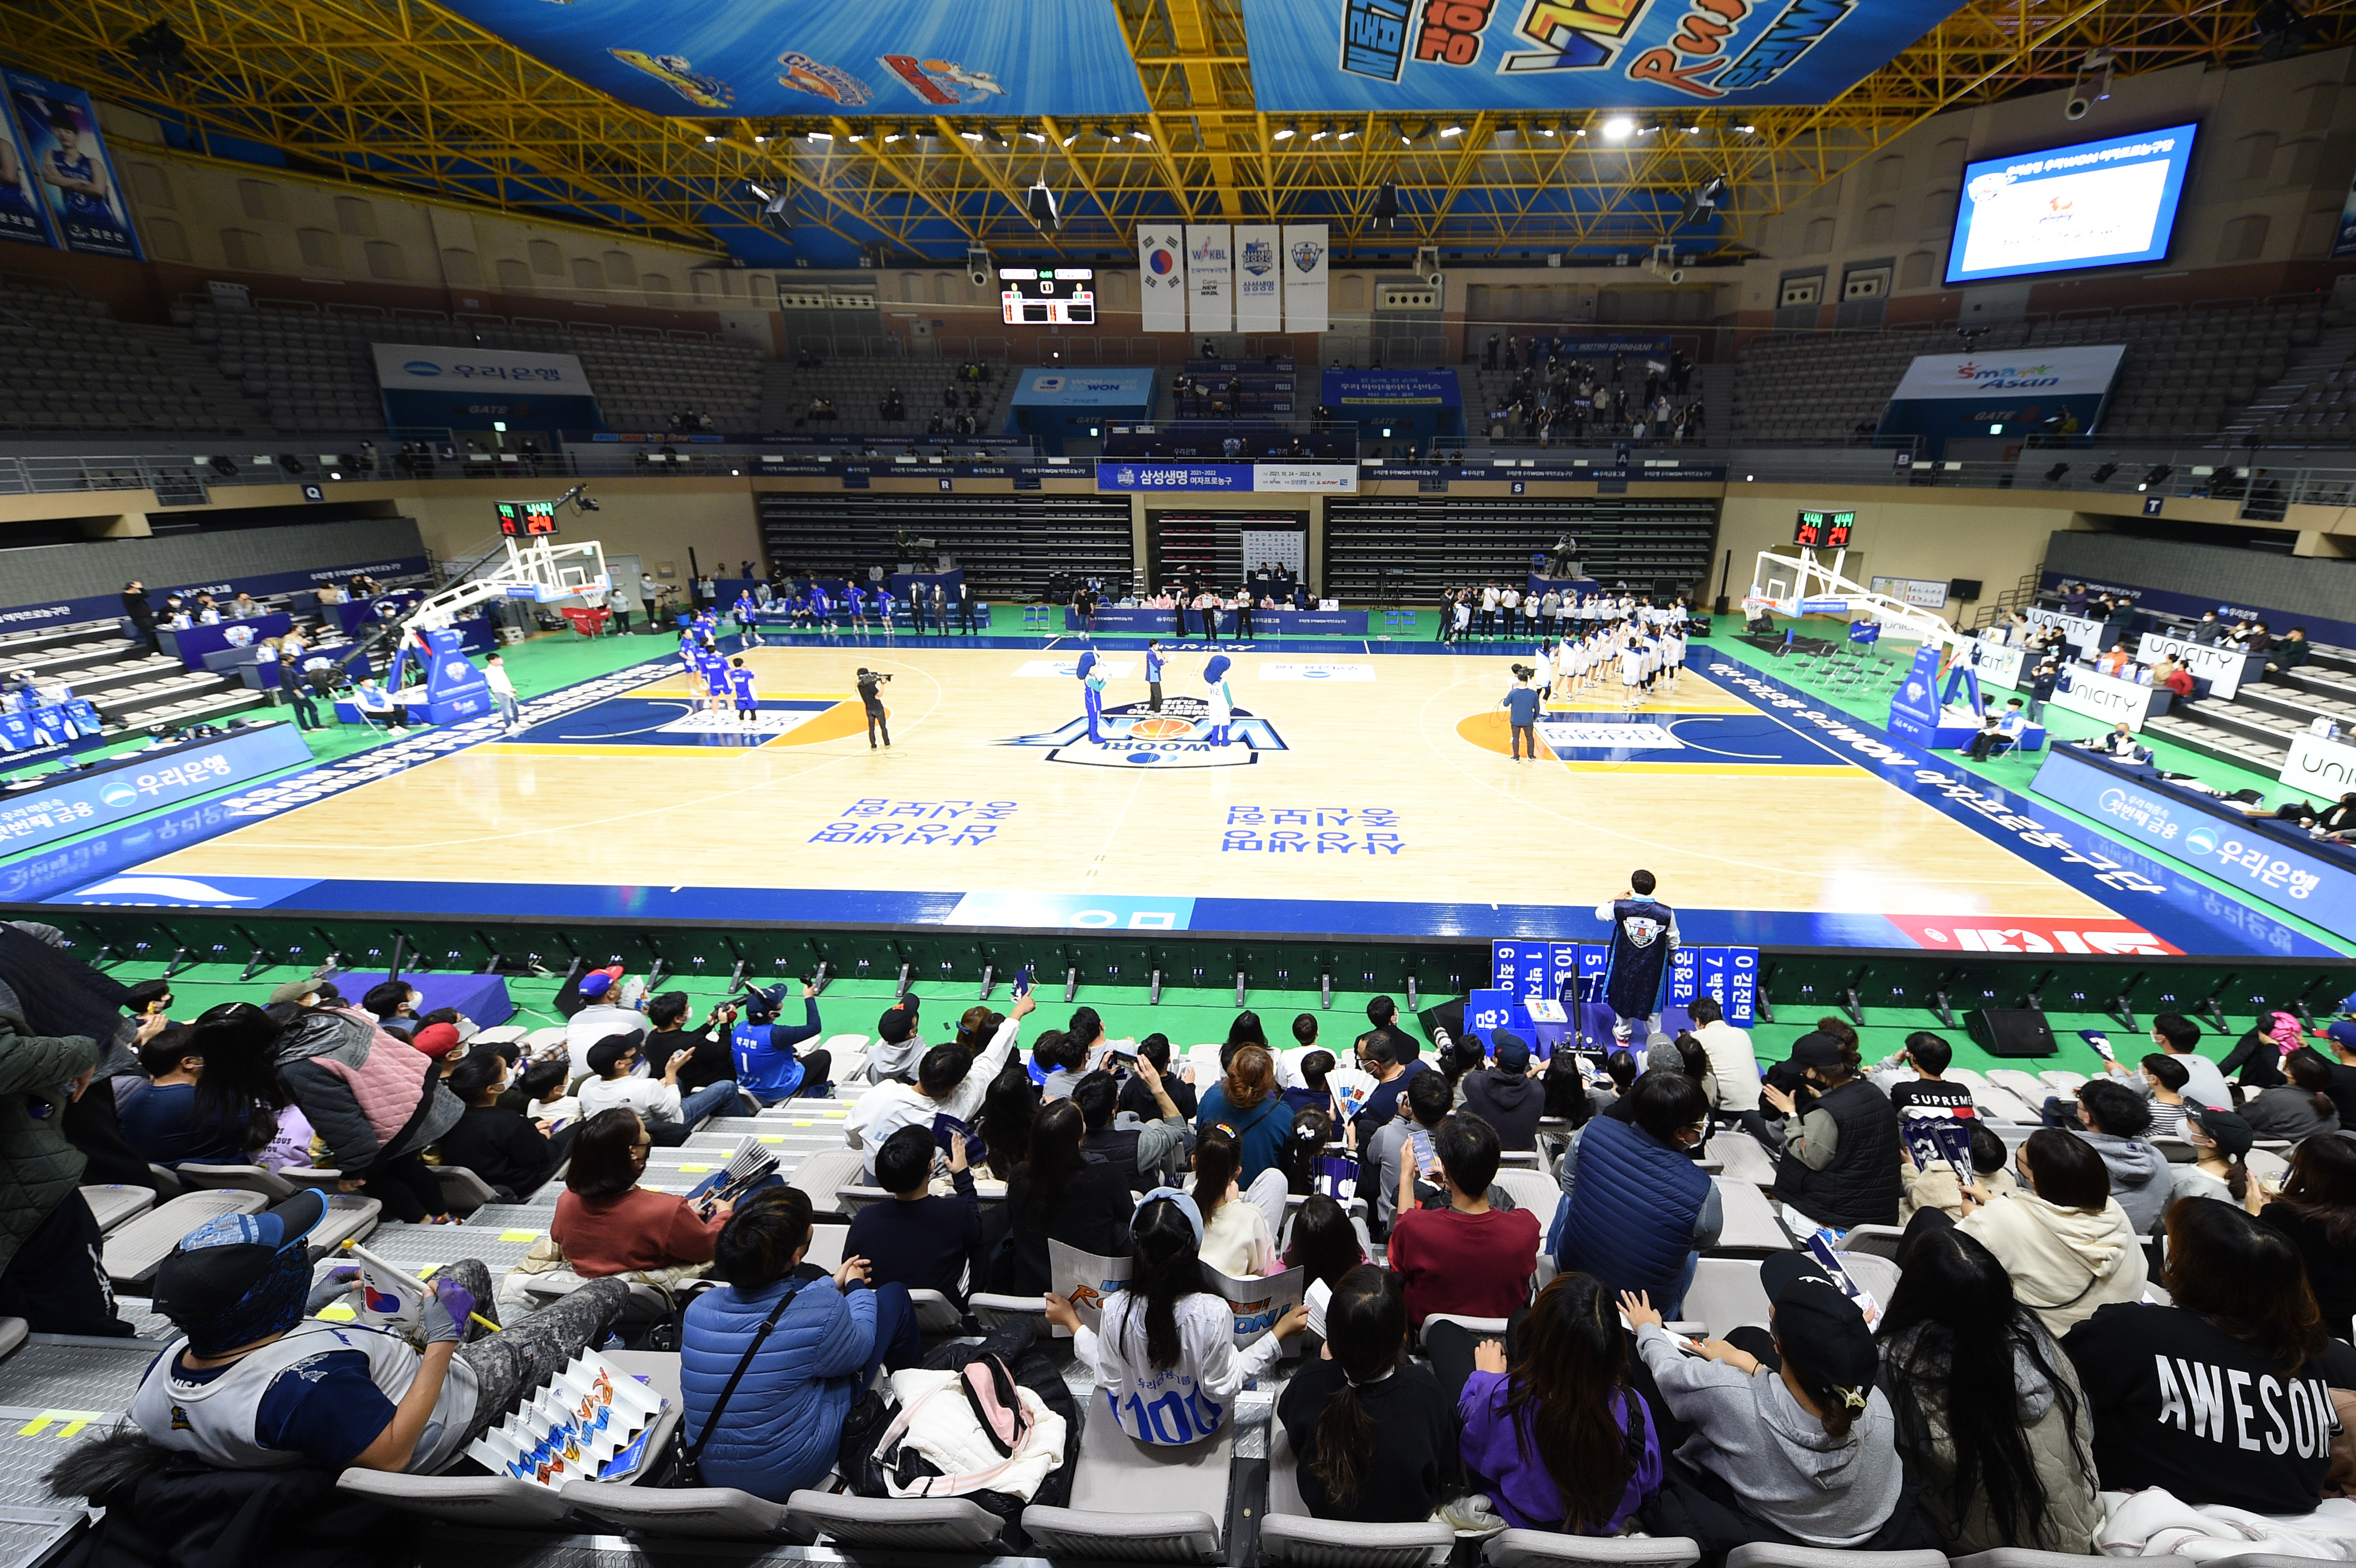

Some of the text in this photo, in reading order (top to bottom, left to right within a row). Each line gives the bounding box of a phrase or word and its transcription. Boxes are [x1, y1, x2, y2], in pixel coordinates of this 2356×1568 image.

[1243, 281, 1275, 292] 삼성생명
[453, 364, 560, 381] 우리은행
[1957, 362, 2054, 380] Smart
[1980, 377, 2059, 390] Asan
[469, 405, 508, 414] GATE
[1974, 410, 2017, 421] GATE
[1173, 447, 1197, 456] 우리은행
[941, 480, 949, 489] R
[1139, 469, 1189, 485] 삼성생명
[1190, 477, 1232, 486] 여자프로농구
[306, 485, 321, 500] Q
[1514, 483, 1522, 492] S
[2149, 500, 2160, 512] T
[527, 515, 553, 535] 24
[1798, 524, 1818, 543] 24
[1828, 527, 1848, 545] 24
[2032, 611, 2094, 636] UNICITY
[2150, 638, 2232, 669] UNICITY
[1101, 742, 1211, 751] WOORI
[137, 754, 232, 795] 우리은행
[220, 770, 348, 809] ASAN
[333, 730, 464, 768] WOORI
[2302, 753, 2356, 785] UNI
[229, 751, 436, 816] WOMEN'S
[840, 798, 1019, 818] 종신보험
[2127, 795, 2146, 809] 우리
[54, 801, 94, 824] 금융
[1227, 806, 1401, 826] 종신보험
[2107, 799, 2179, 839] 첫번째 금융
[807, 821, 998, 846] 삼성생명
[1913, 769, 2168, 895] 여자프로농구단
[1222, 829, 1408, 855] 삼성생명
[2215, 840, 2321, 899] 우리은행
[1627, 926, 1655, 937] WON
[1498, 947, 1515, 959] 6
[1555, 947, 1572, 966] 10
[1585, 954, 1602, 966] 5
[1706, 956, 1723, 968] 7
[1674, 950, 1694, 1000] 김정은
[1731, 956, 1754, 1019] 0 김진희
[741, 1052, 749, 1073] 1
[1910, 1093, 1972, 1106] SUPREME
[1125, 1383, 1223, 1444] 100
